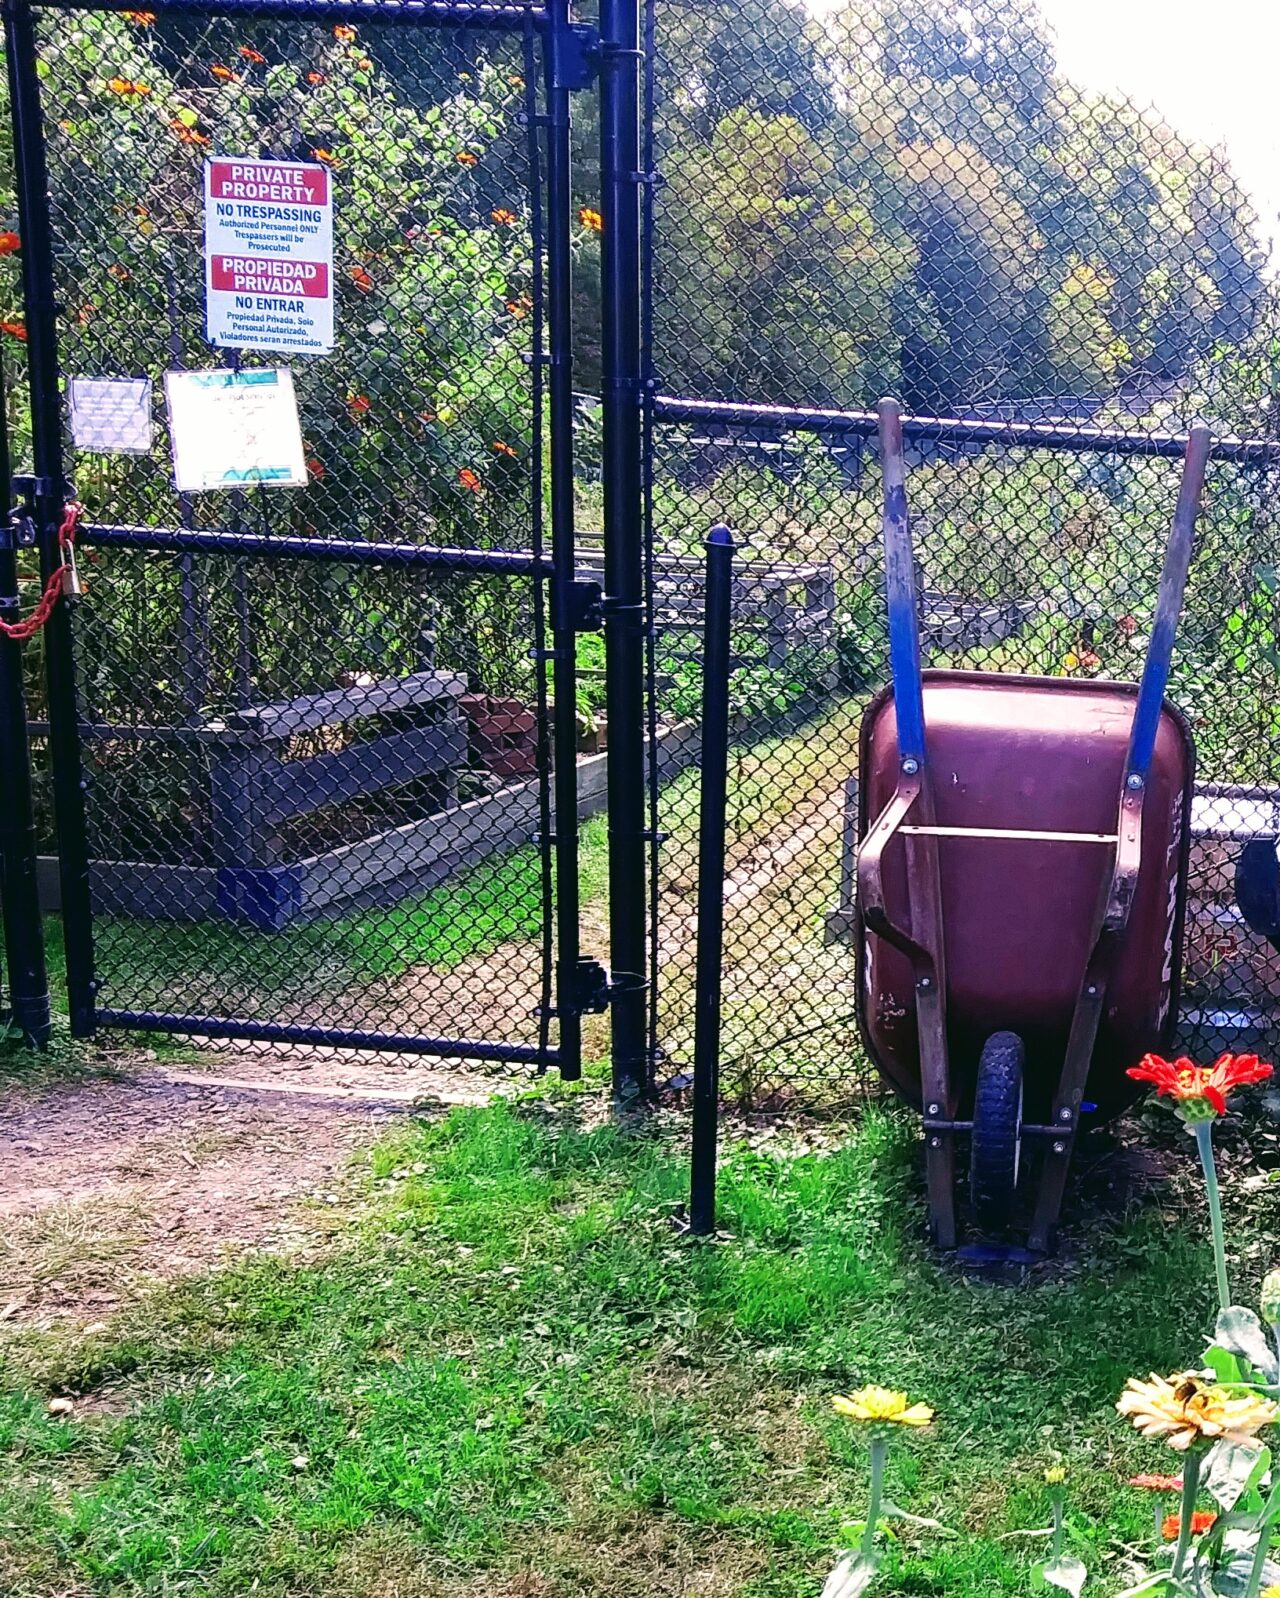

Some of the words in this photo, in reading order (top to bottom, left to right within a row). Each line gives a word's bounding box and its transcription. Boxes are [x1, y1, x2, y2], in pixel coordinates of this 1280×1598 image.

[231, 166, 304, 185] PRIVATE
[222, 181, 315, 202] PROPERTY
[216, 203, 234, 216] NO
[236, 205, 322, 223] TRESPASSING
[219, 219, 259, 229] Authorized
[261, 222, 298, 232] Personnel
[300, 225, 319, 233] ONLY
[234, 230, 279, 241] Trespassers
[280, 233, 293, 242] will
[294, 235, 304, 243] be
[248, 242, 291, 252] Prosecuted
[222, 258, 317, 279] PROPIEDAD
[234, 275, 306, 295] PRIVADA
[235, 296, 253, 309] NO
[256, 298, 305, 313] ENTRAR
[226, 312, 265, 322] Propiedad
[232, 323, 266, 333] Personal
[219, 332, 259, 342] Violadores
[260, 336, 281, 344] seran
[282, 336, 322, 347] arrestados
